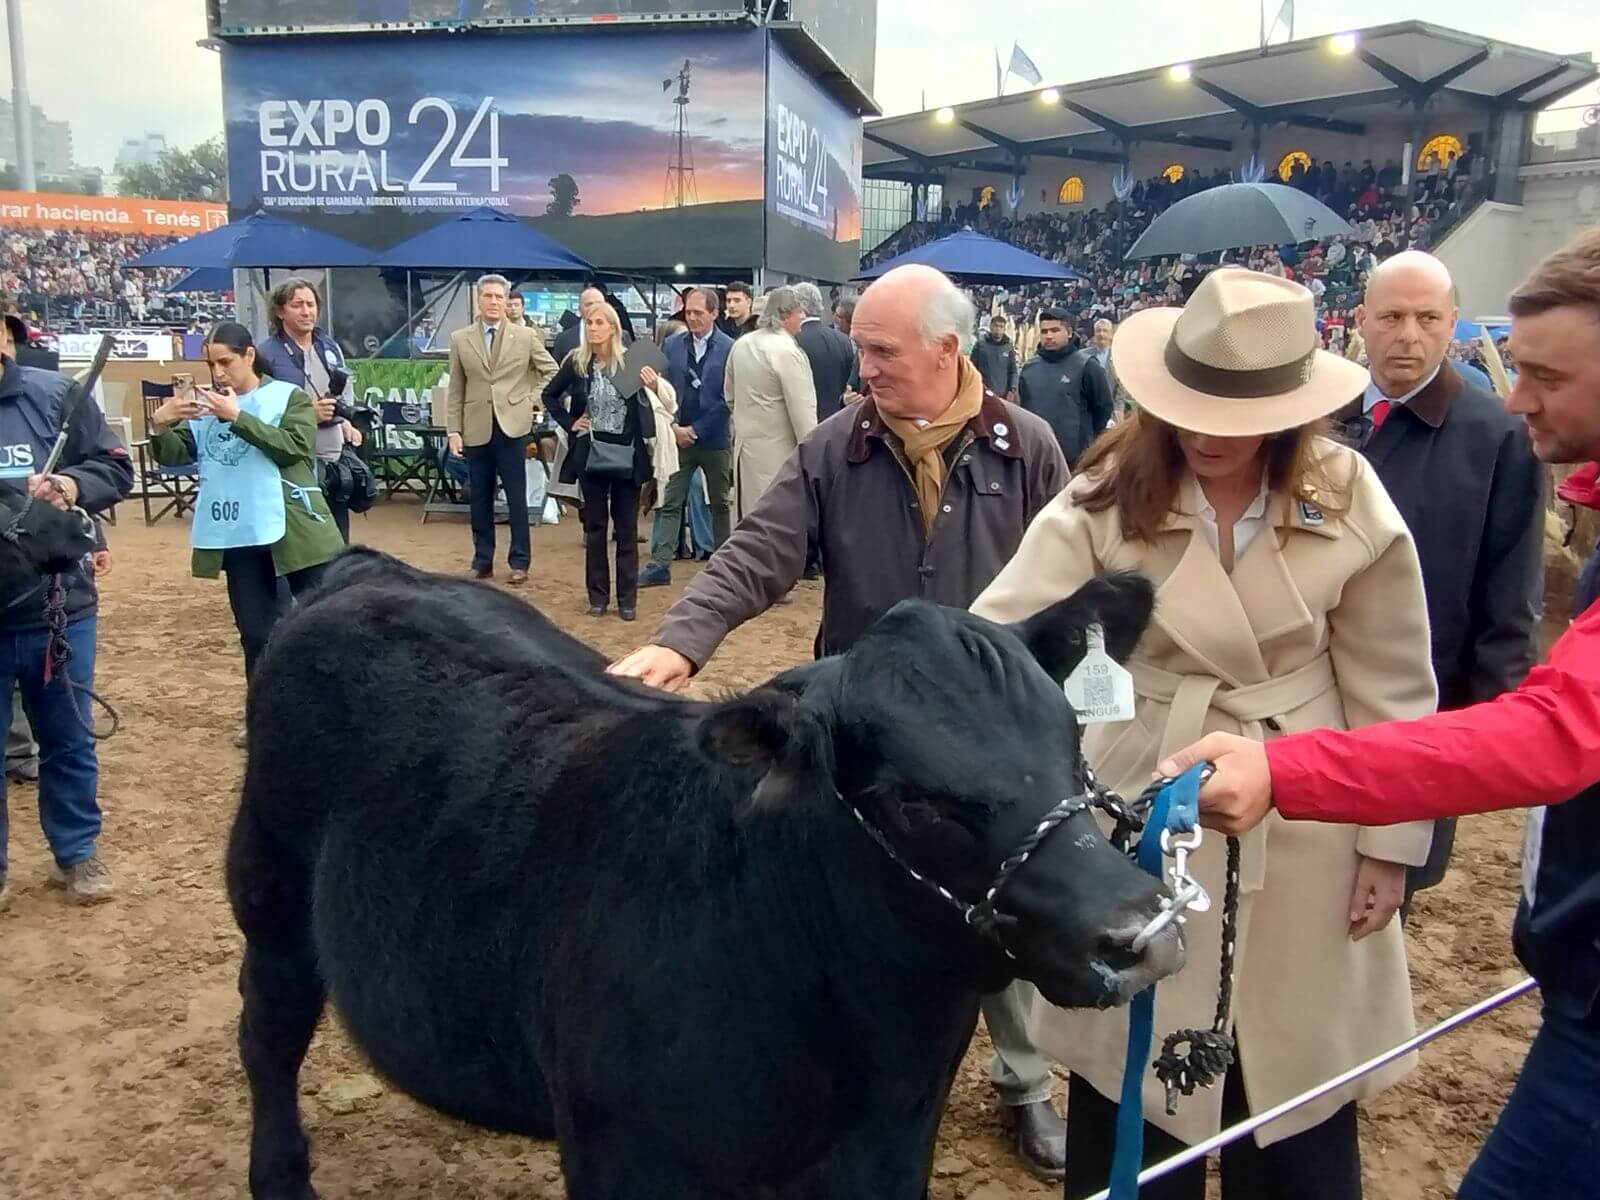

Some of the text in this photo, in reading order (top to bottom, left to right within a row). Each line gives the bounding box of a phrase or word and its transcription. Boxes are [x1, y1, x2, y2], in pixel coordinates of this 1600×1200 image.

[259, 99, 391, 146] EXPO
[408, 96, 509, 192] 24
[778, 103, 807, 165] EXPO
[261, 150, 405, 192] RURAL
[776, 155, 810, 210] RURAL
[809, 127, 828, 217] 24
[142, 208, 200, 227] Tenés
[211, 501, 239, 521] 608
